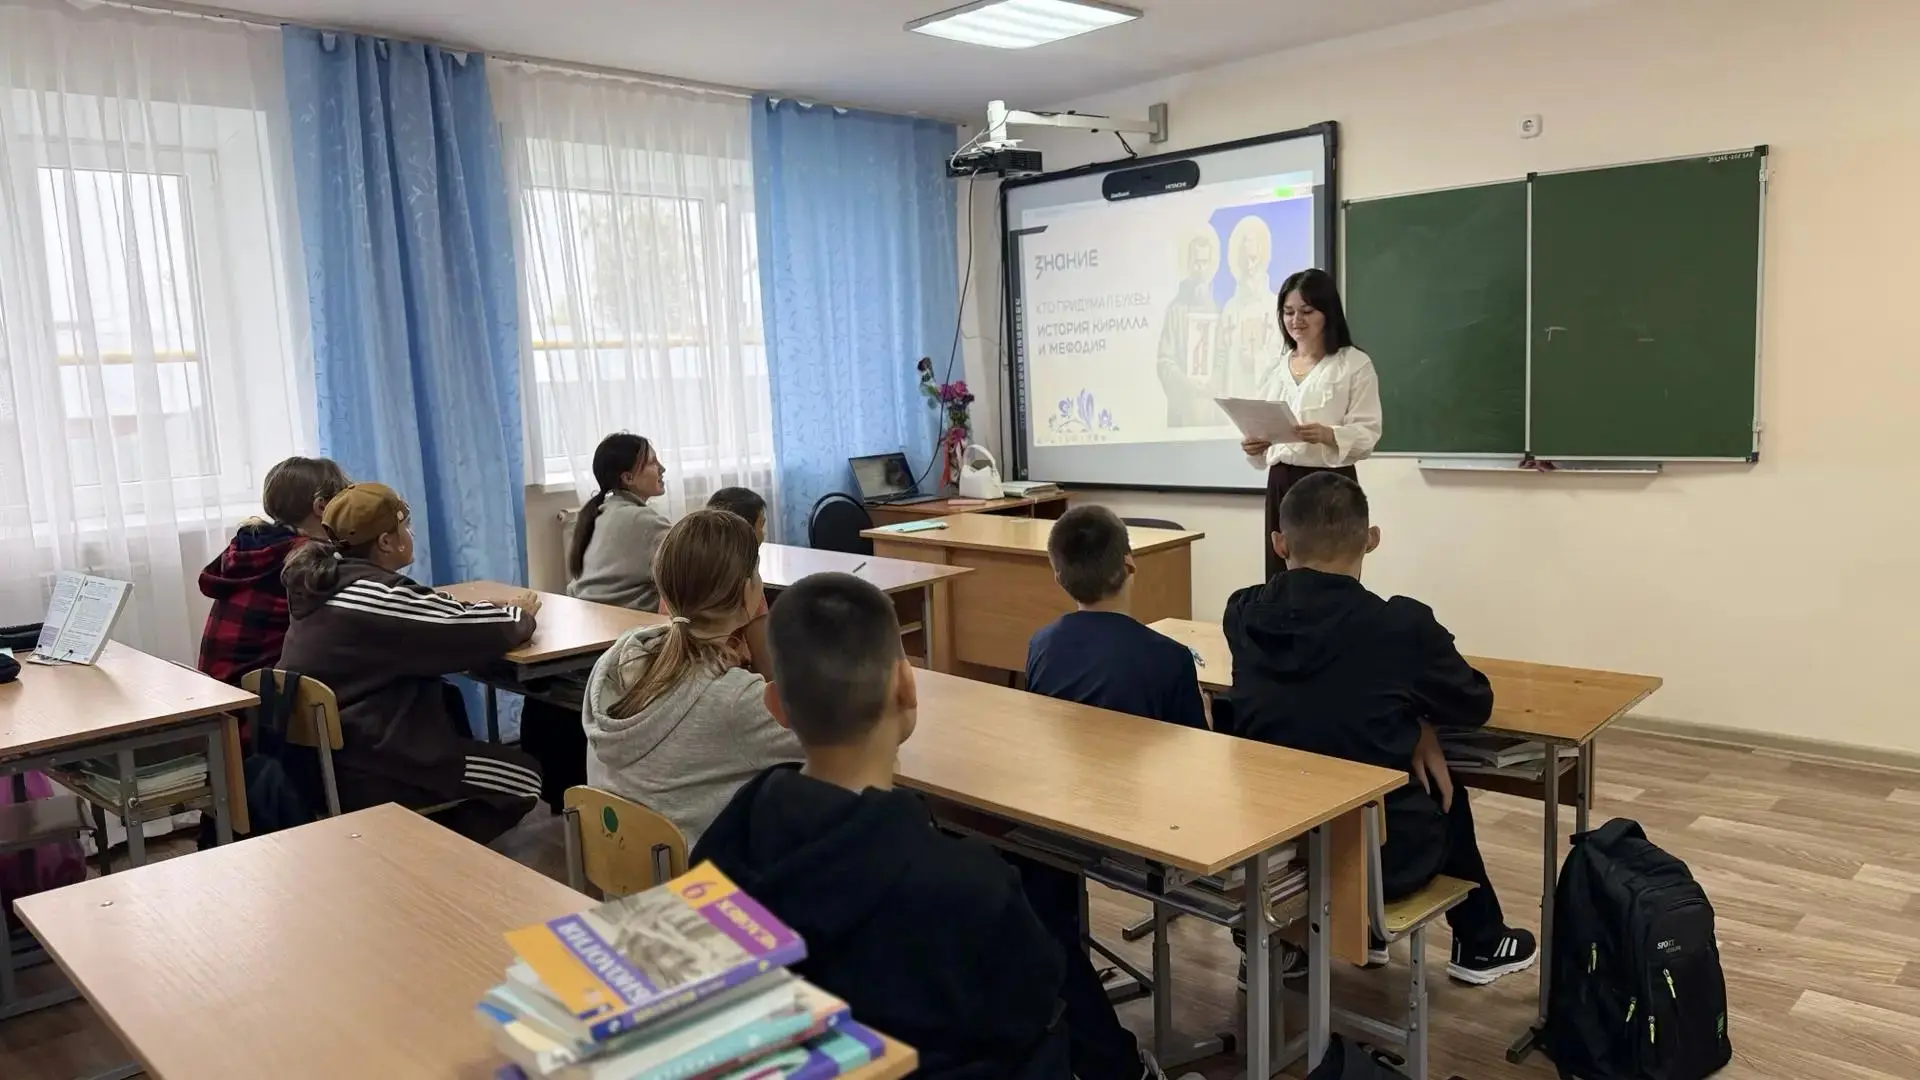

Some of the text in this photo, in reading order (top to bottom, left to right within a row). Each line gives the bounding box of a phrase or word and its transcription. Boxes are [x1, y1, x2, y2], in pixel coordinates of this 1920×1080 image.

[1037, 315, 1149, 337] ИСТОРИЯ КИРИЛЛА
[1037, 338, 1107, 356] И МЕФОДИЯ
